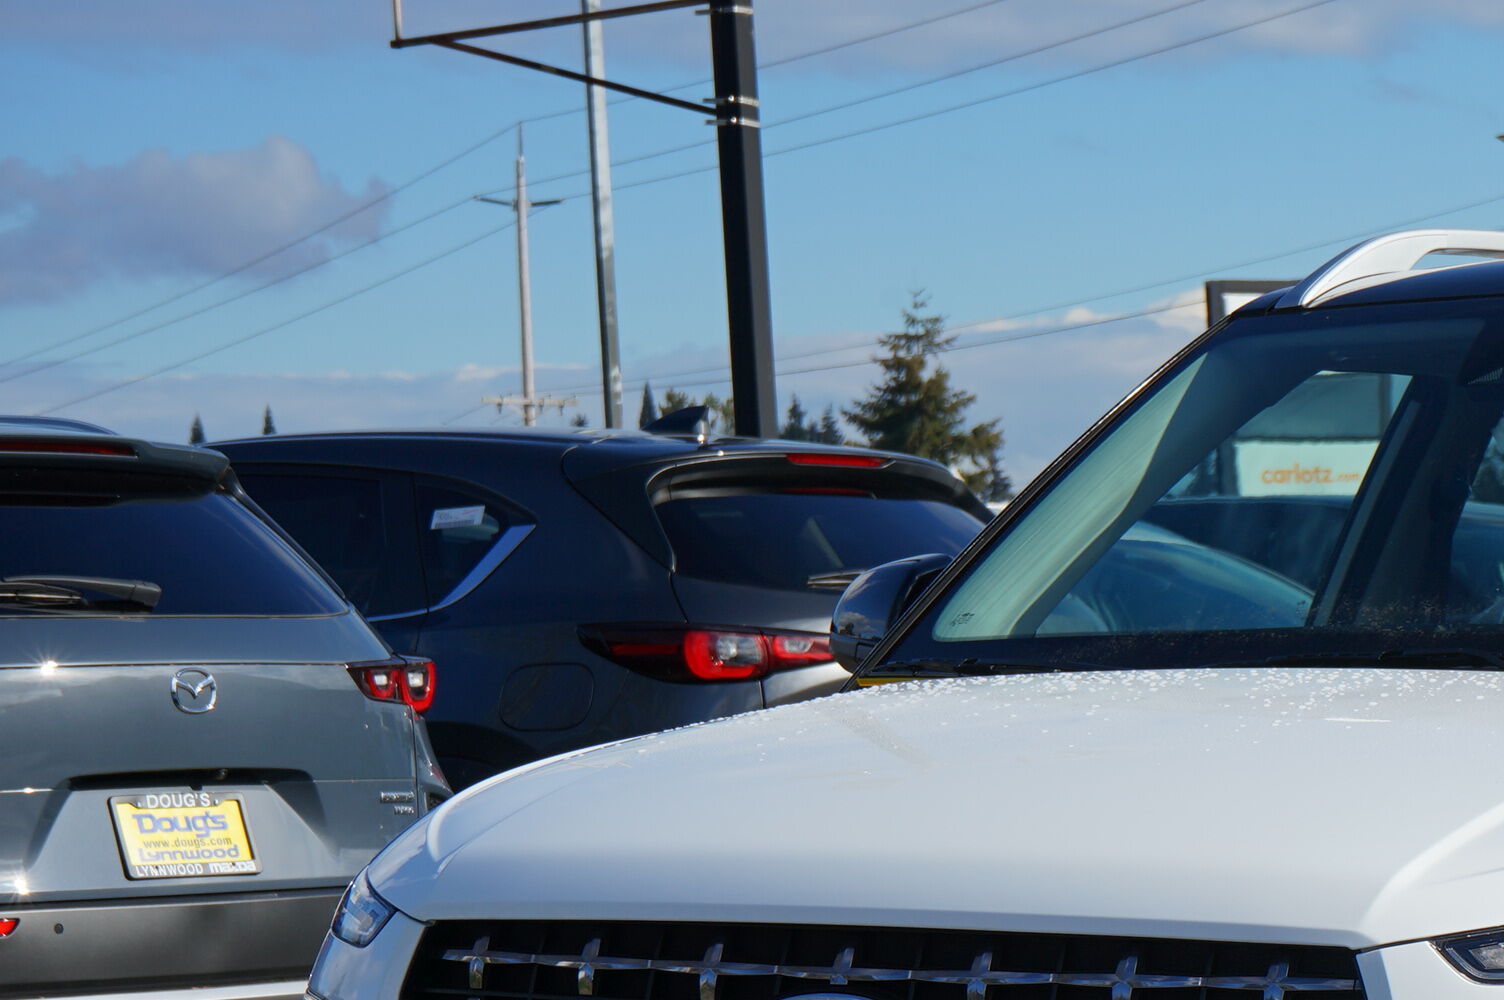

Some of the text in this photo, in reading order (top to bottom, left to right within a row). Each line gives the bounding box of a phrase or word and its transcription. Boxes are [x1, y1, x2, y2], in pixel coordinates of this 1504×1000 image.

[146, 793, 210, 808] DOUG'S
[131, 811, 228, 838] Doug's
[142, 837, 232, 848] www.dougs.com
[139, 844, 239, 862] Lynnwood
[135, 863, 203, 876] LYNNWOOD
